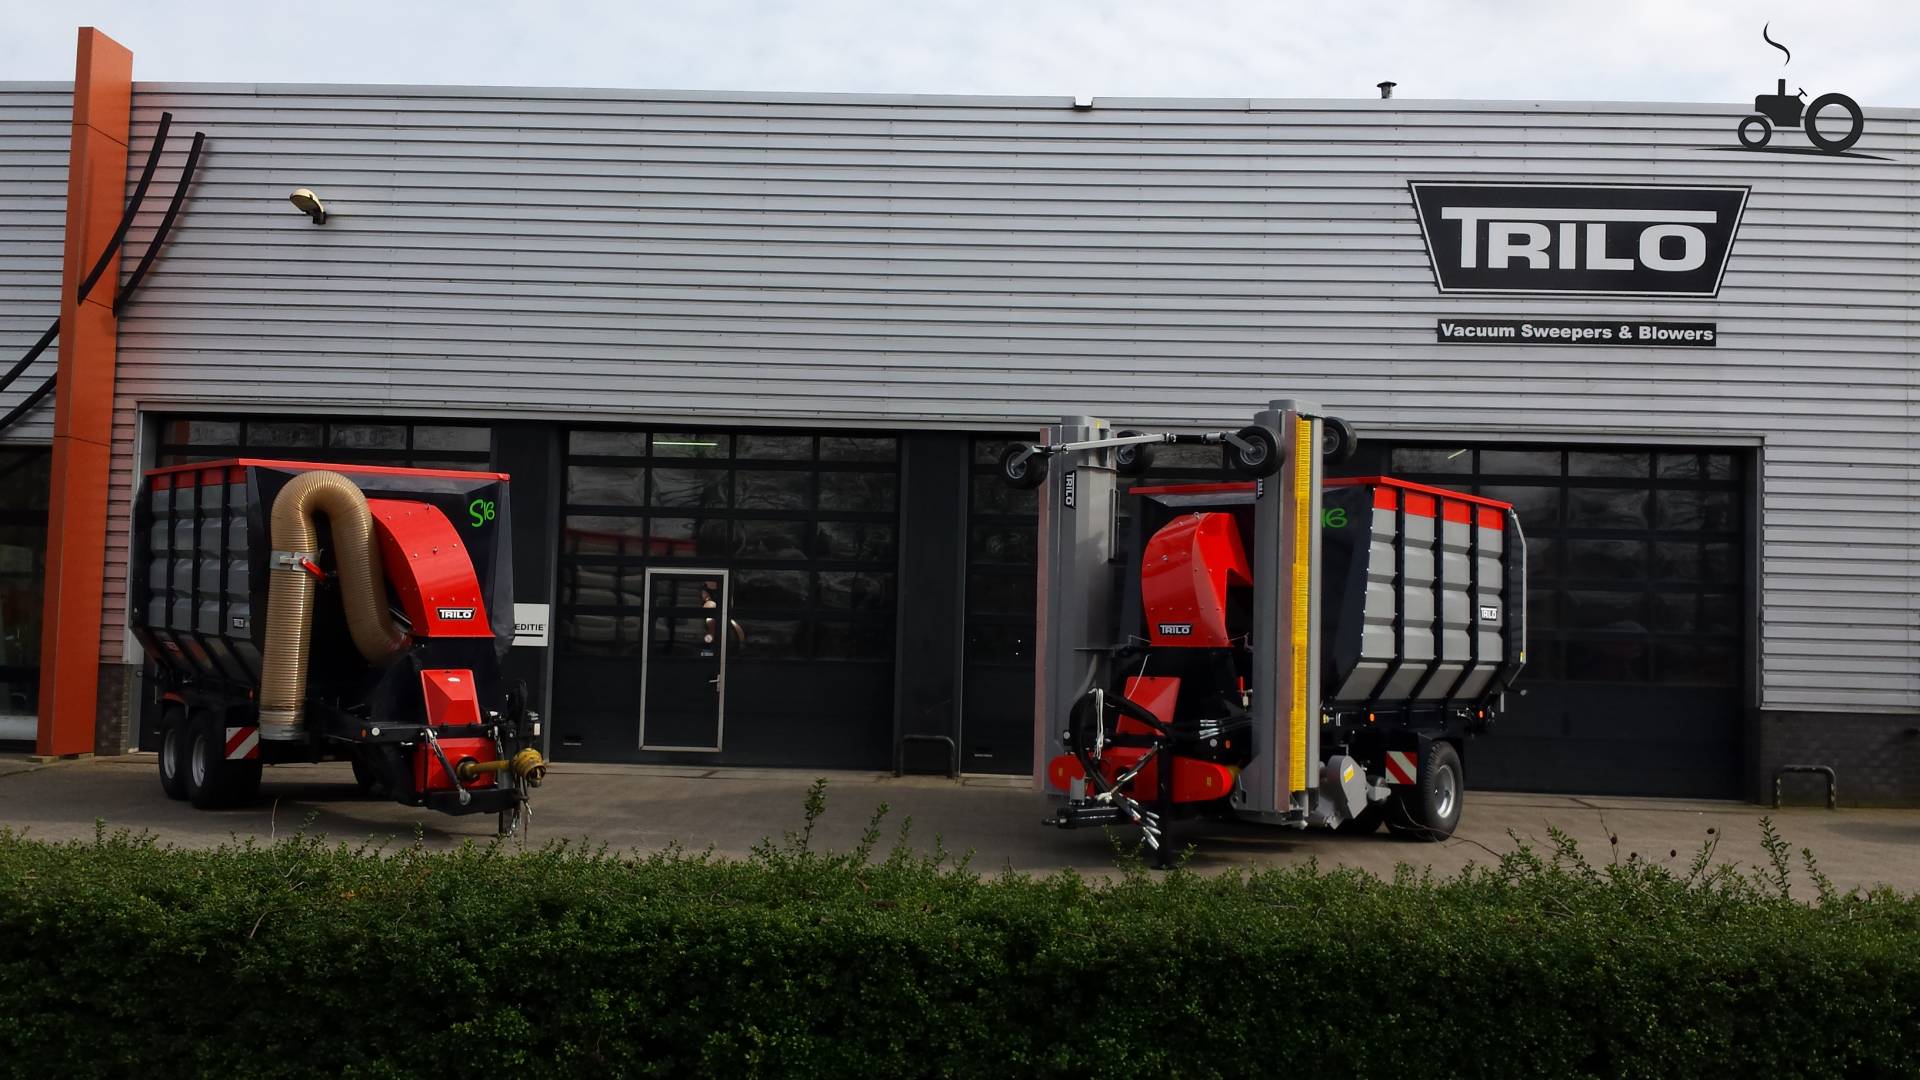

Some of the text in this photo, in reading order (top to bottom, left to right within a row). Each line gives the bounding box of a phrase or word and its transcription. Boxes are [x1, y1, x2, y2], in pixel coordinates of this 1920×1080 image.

[1441, 206, 1718, 272] TRILO
[1441, 323, 1714, 342] Vacuum Sweepers & Blowers
[1065, 471, 1075, 507] TRILO
[469, 499, 496, 528] S16
[1321, 507, 1348, 528] 16
[439, 609, 474, 619] TRILO
[514, 623, 544, 631] EDITIE
[1159, 624, 1191, 634] TRILO
